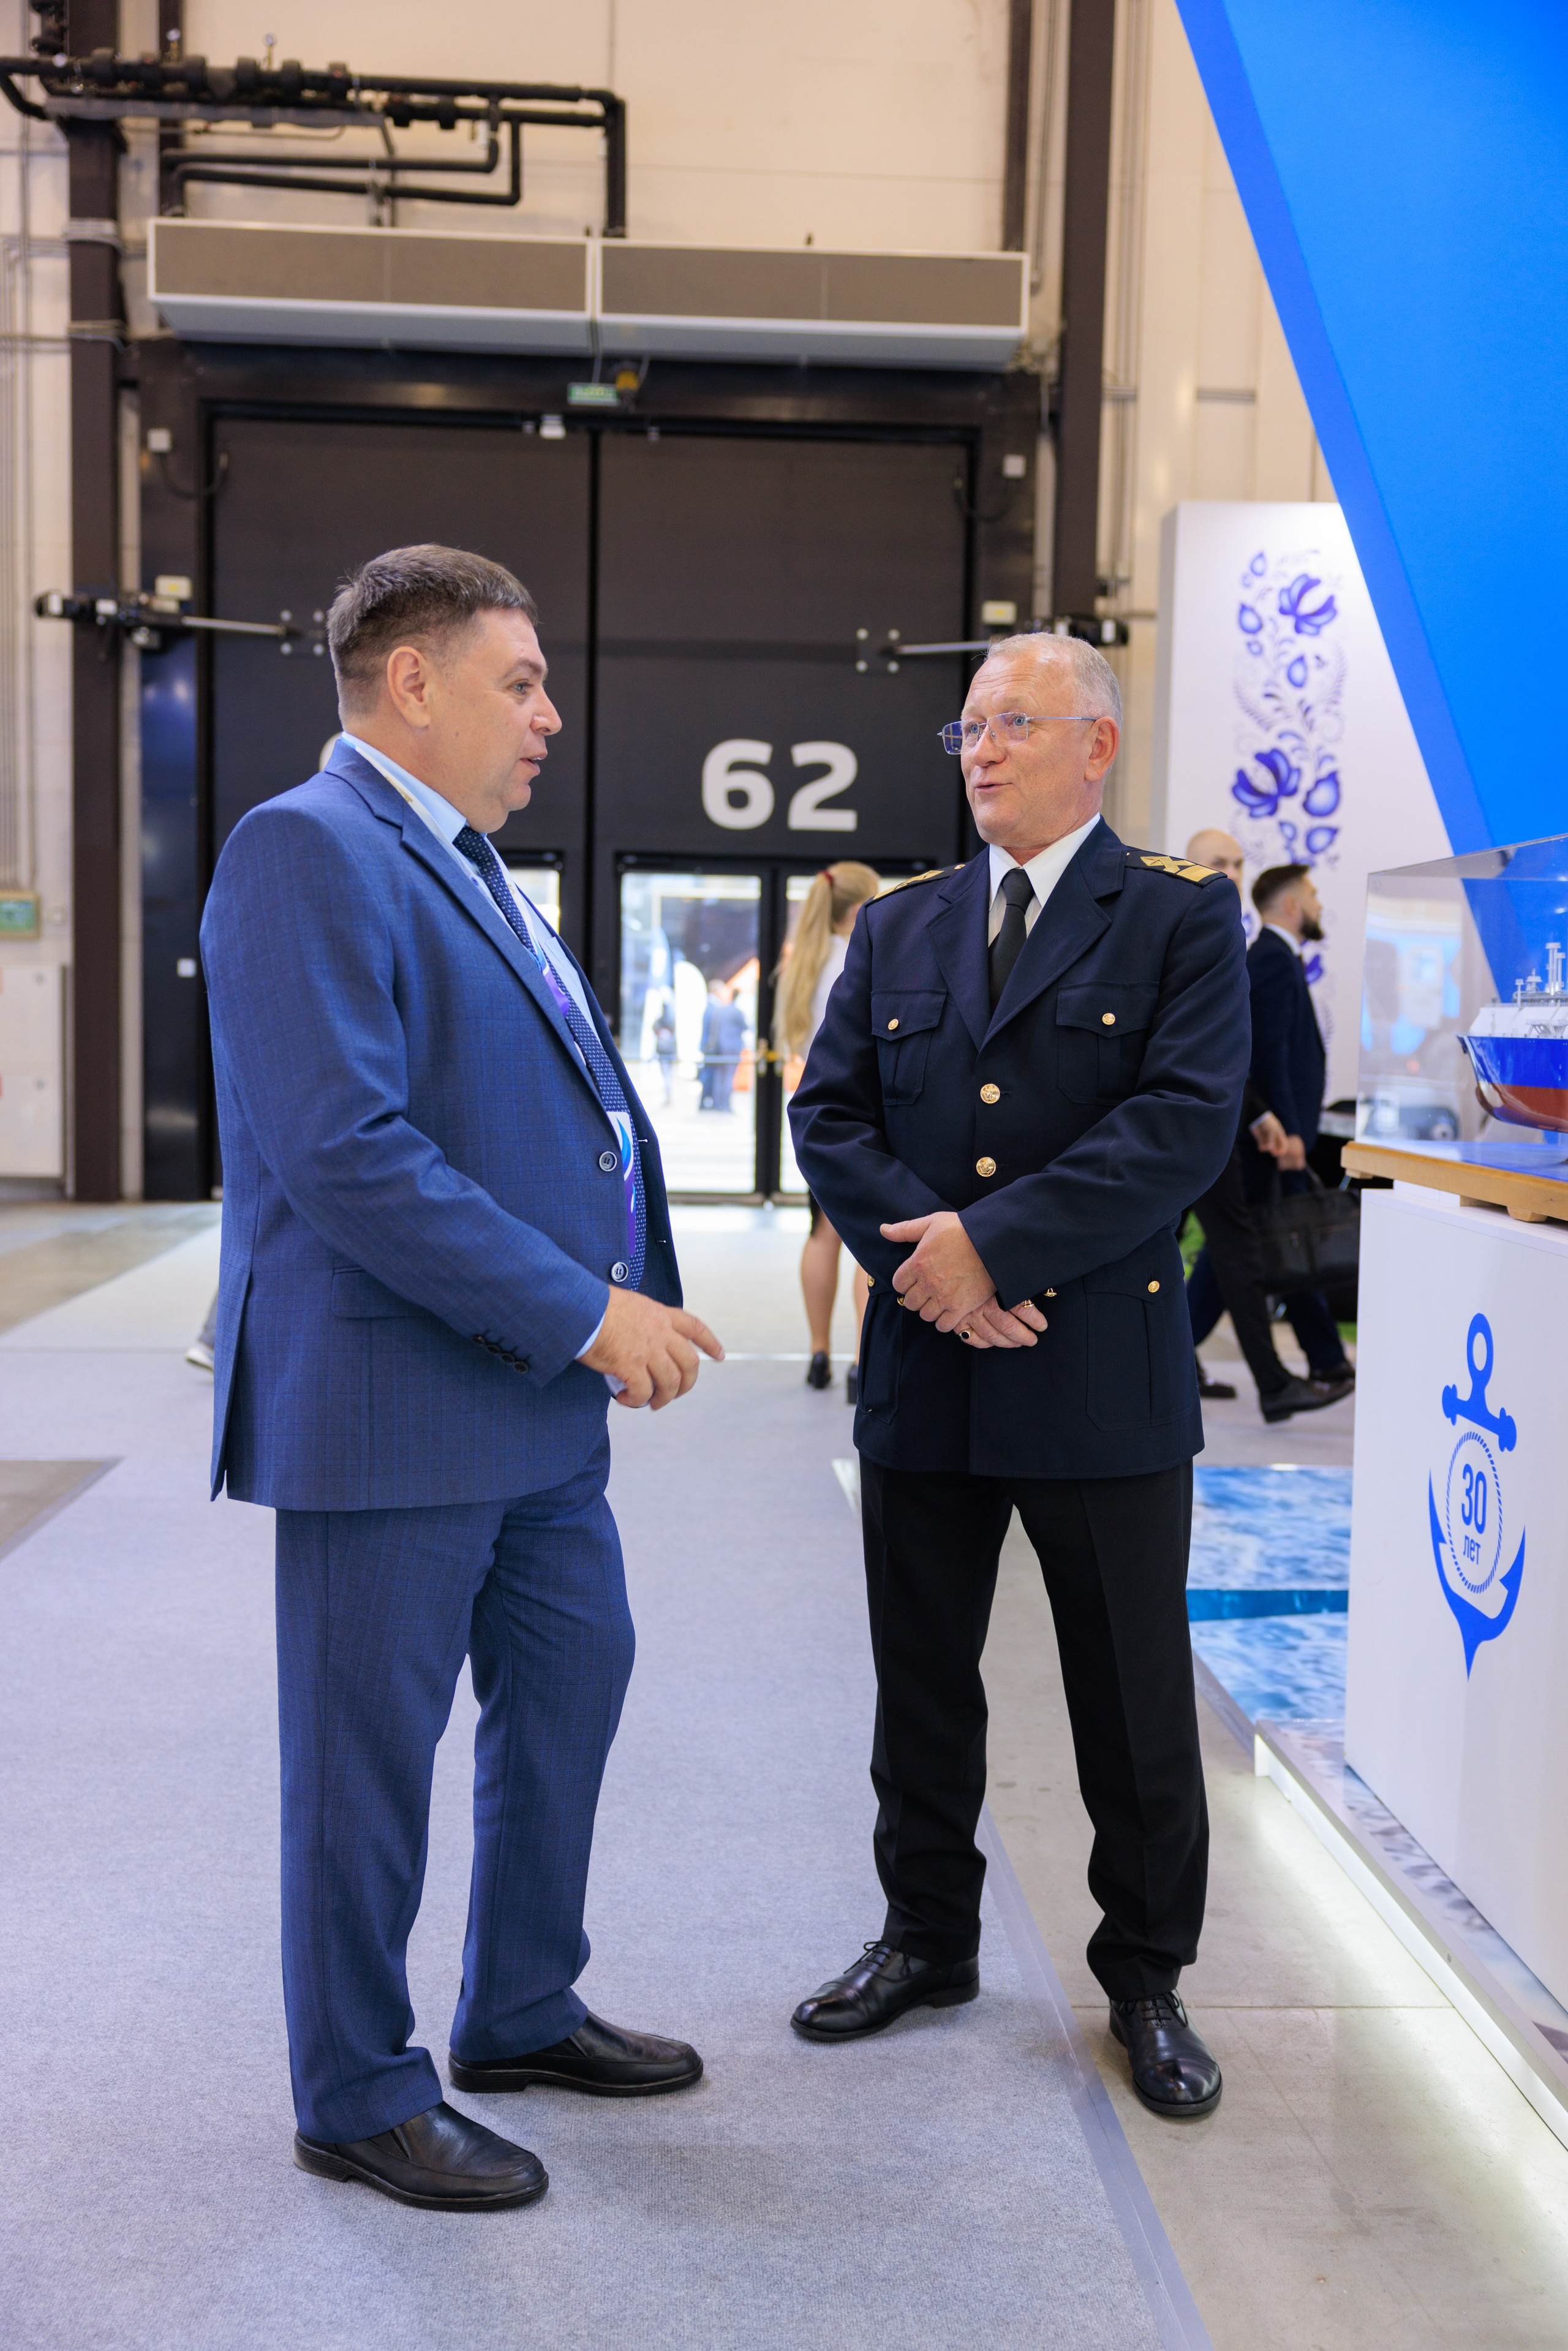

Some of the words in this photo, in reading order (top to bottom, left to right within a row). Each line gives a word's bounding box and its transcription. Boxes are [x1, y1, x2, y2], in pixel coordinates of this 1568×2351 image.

[702, 738, 858, 832] 62
[1461, 1463, 1487, 1534] 30
[1463, 1534, 1481, 1565] лет
